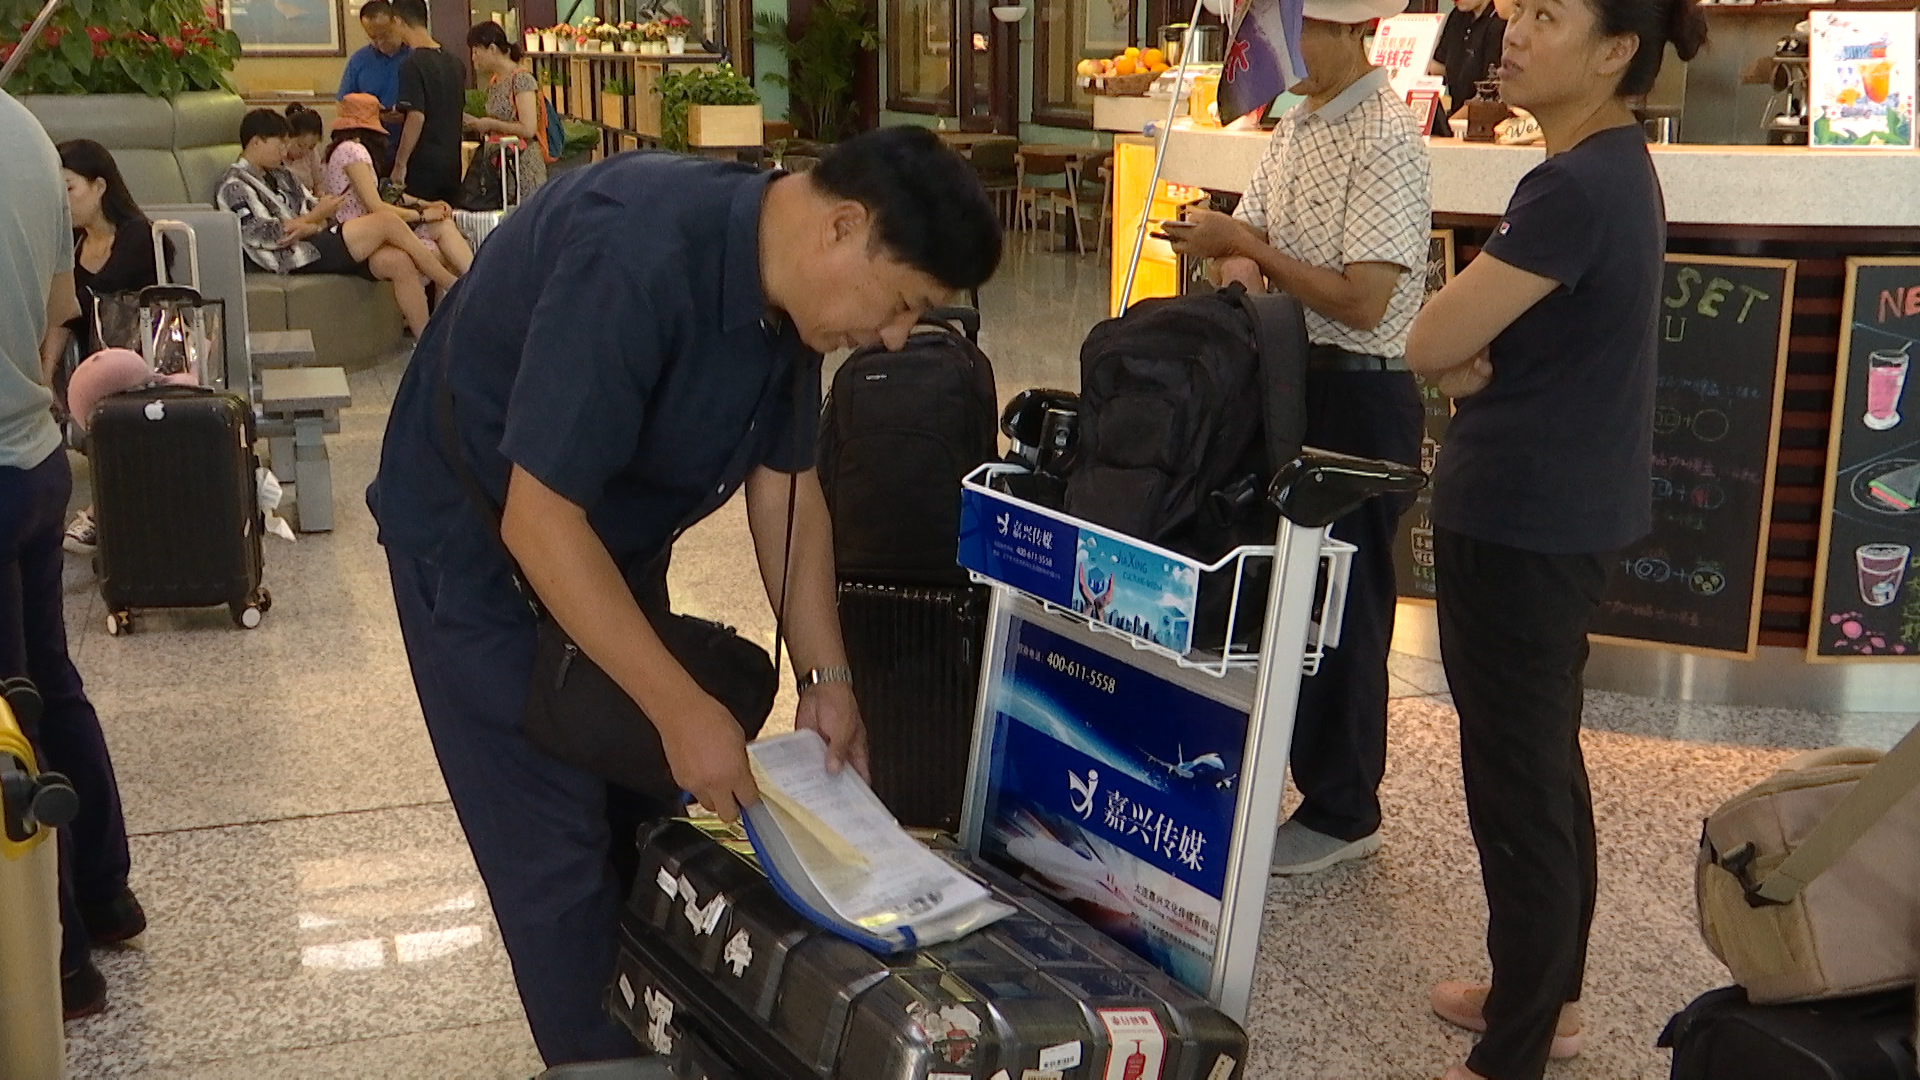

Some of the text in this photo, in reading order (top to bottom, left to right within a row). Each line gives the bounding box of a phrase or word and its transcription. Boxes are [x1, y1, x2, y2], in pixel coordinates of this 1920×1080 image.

[1374, 49, 1414, 68] 当钱花
[1505, 119, 1541, 138] We
[1664, 267, 1770, 324] SET
[1012, 520, 1054, 549] 嘉兴传媒
[1047, 651, 1116, 694] 400-611-5558
[1103, 789, 1206, 872] 嘉兴传媒
